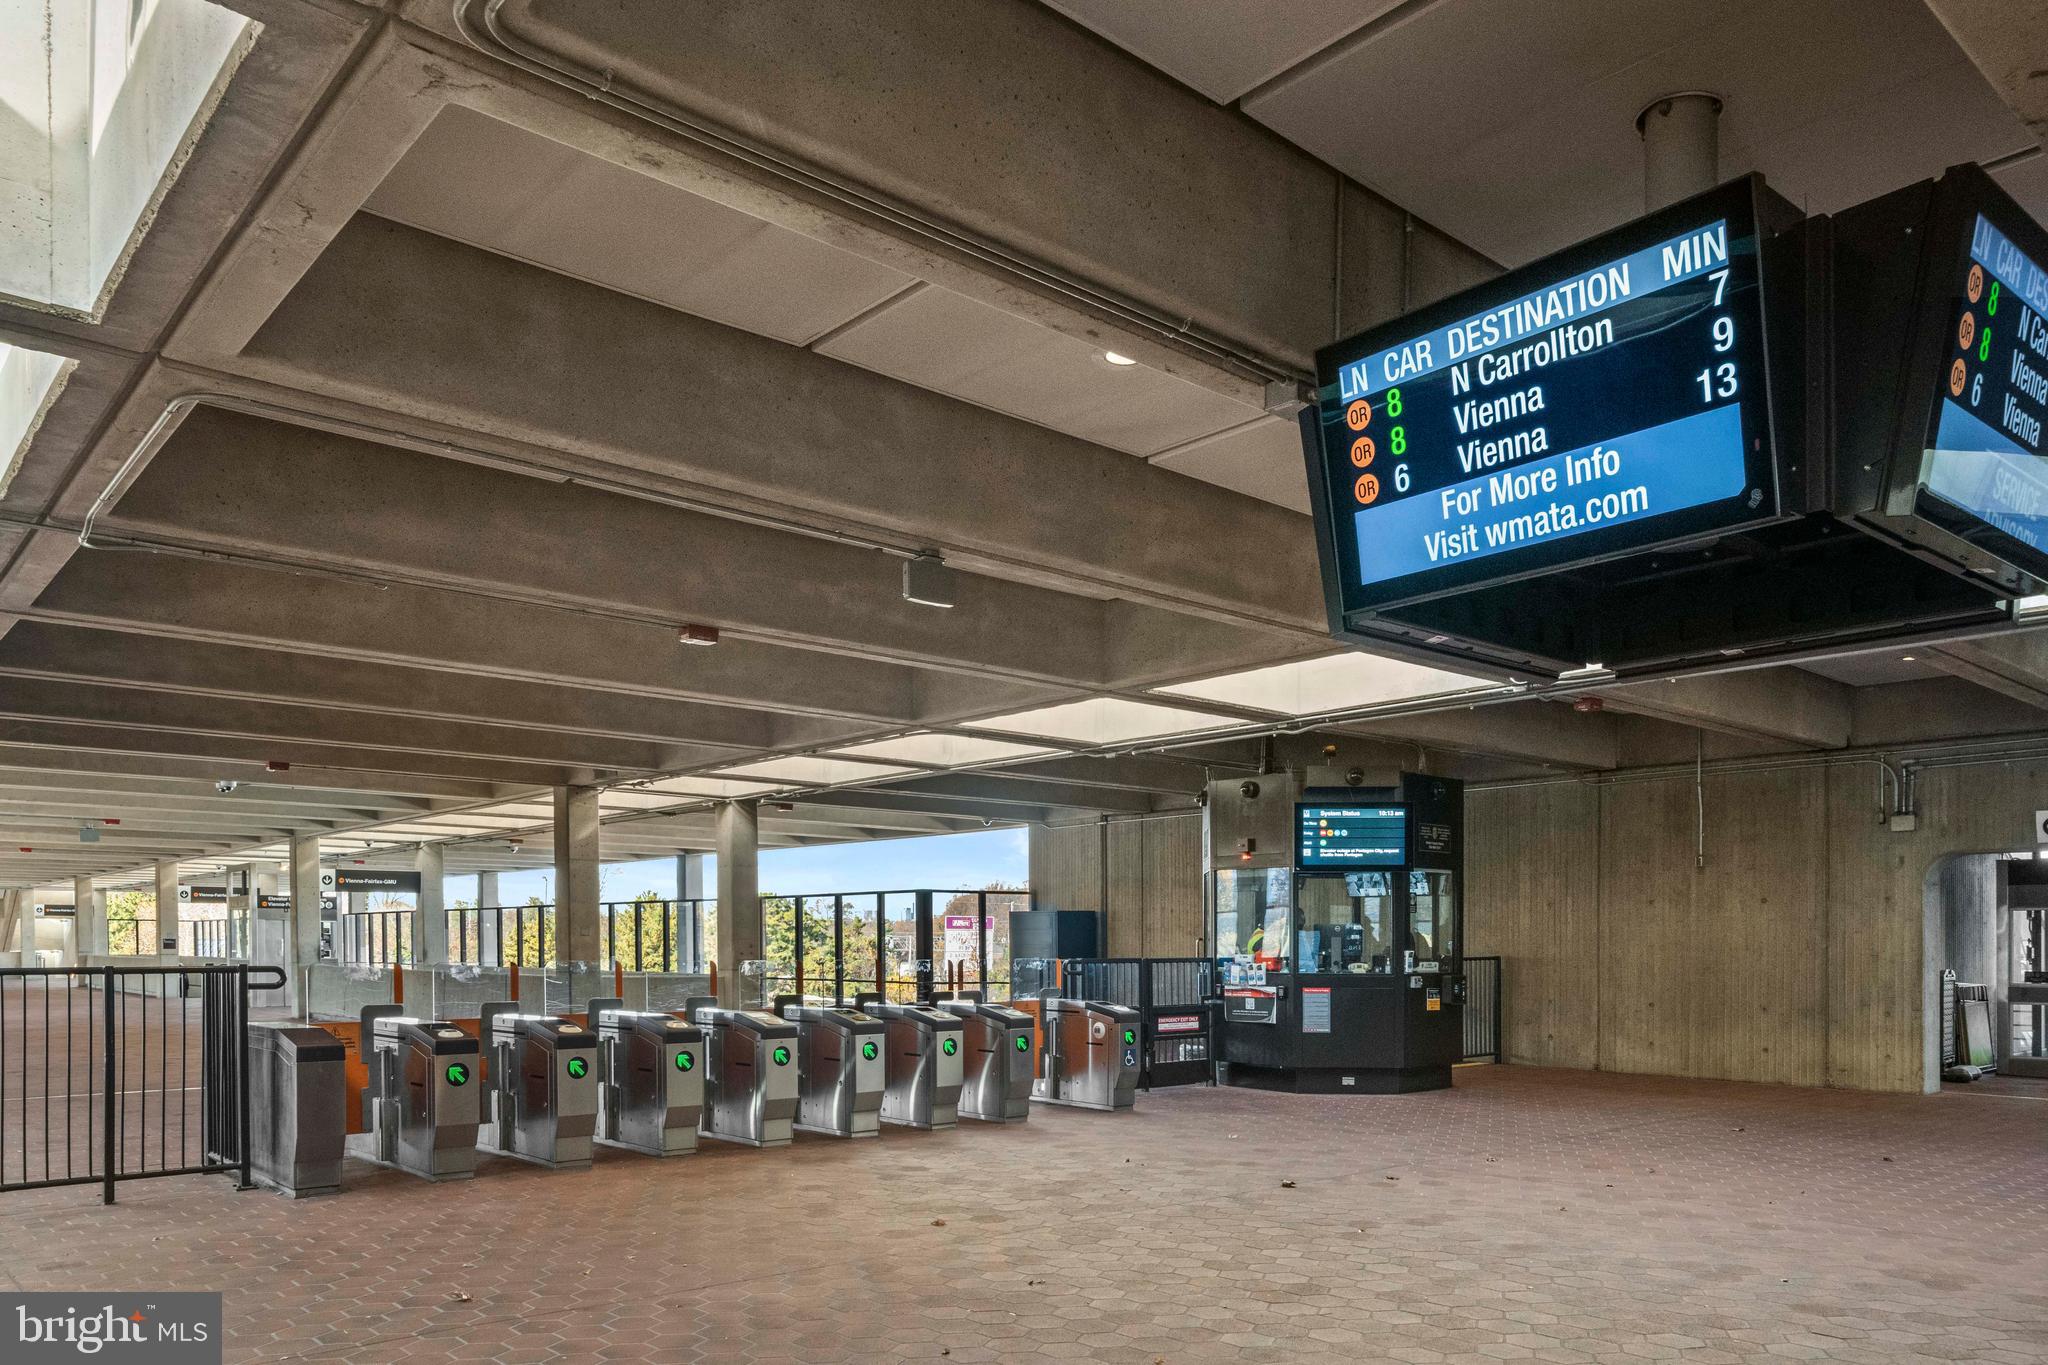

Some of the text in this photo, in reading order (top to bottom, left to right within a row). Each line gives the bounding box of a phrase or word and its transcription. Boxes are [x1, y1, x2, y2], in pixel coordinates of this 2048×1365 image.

[1972, 213, 1993, 261] LN
[1997, 239, 2023, 289] CAR
[1339, 226, 1728, 400] LN CAR DESTINATION MIN
[1350, 269, 1729, 426] OR 8 N Carrollton 7
[1988, 281, 1999, 316] 8
[2018, 305, 2032, 342] N
[1354, 316, 1734, 463] OR 8 Vienna 9
[1979, 328, 1991, 361] 8
[2011, 349, 2048, 406] Vienna
[1358, 362, 1738, 499] OR 6 Vienna 13
[1971, 373, 1983, 407] 6
[2003, 393, 2041, 447] Vienna
[1441, 446, 1621, 521] For More Info
[1993, 467, 2041, 521] SERVICE
[1423, 485, 1649, 562] Visit wmata.com
